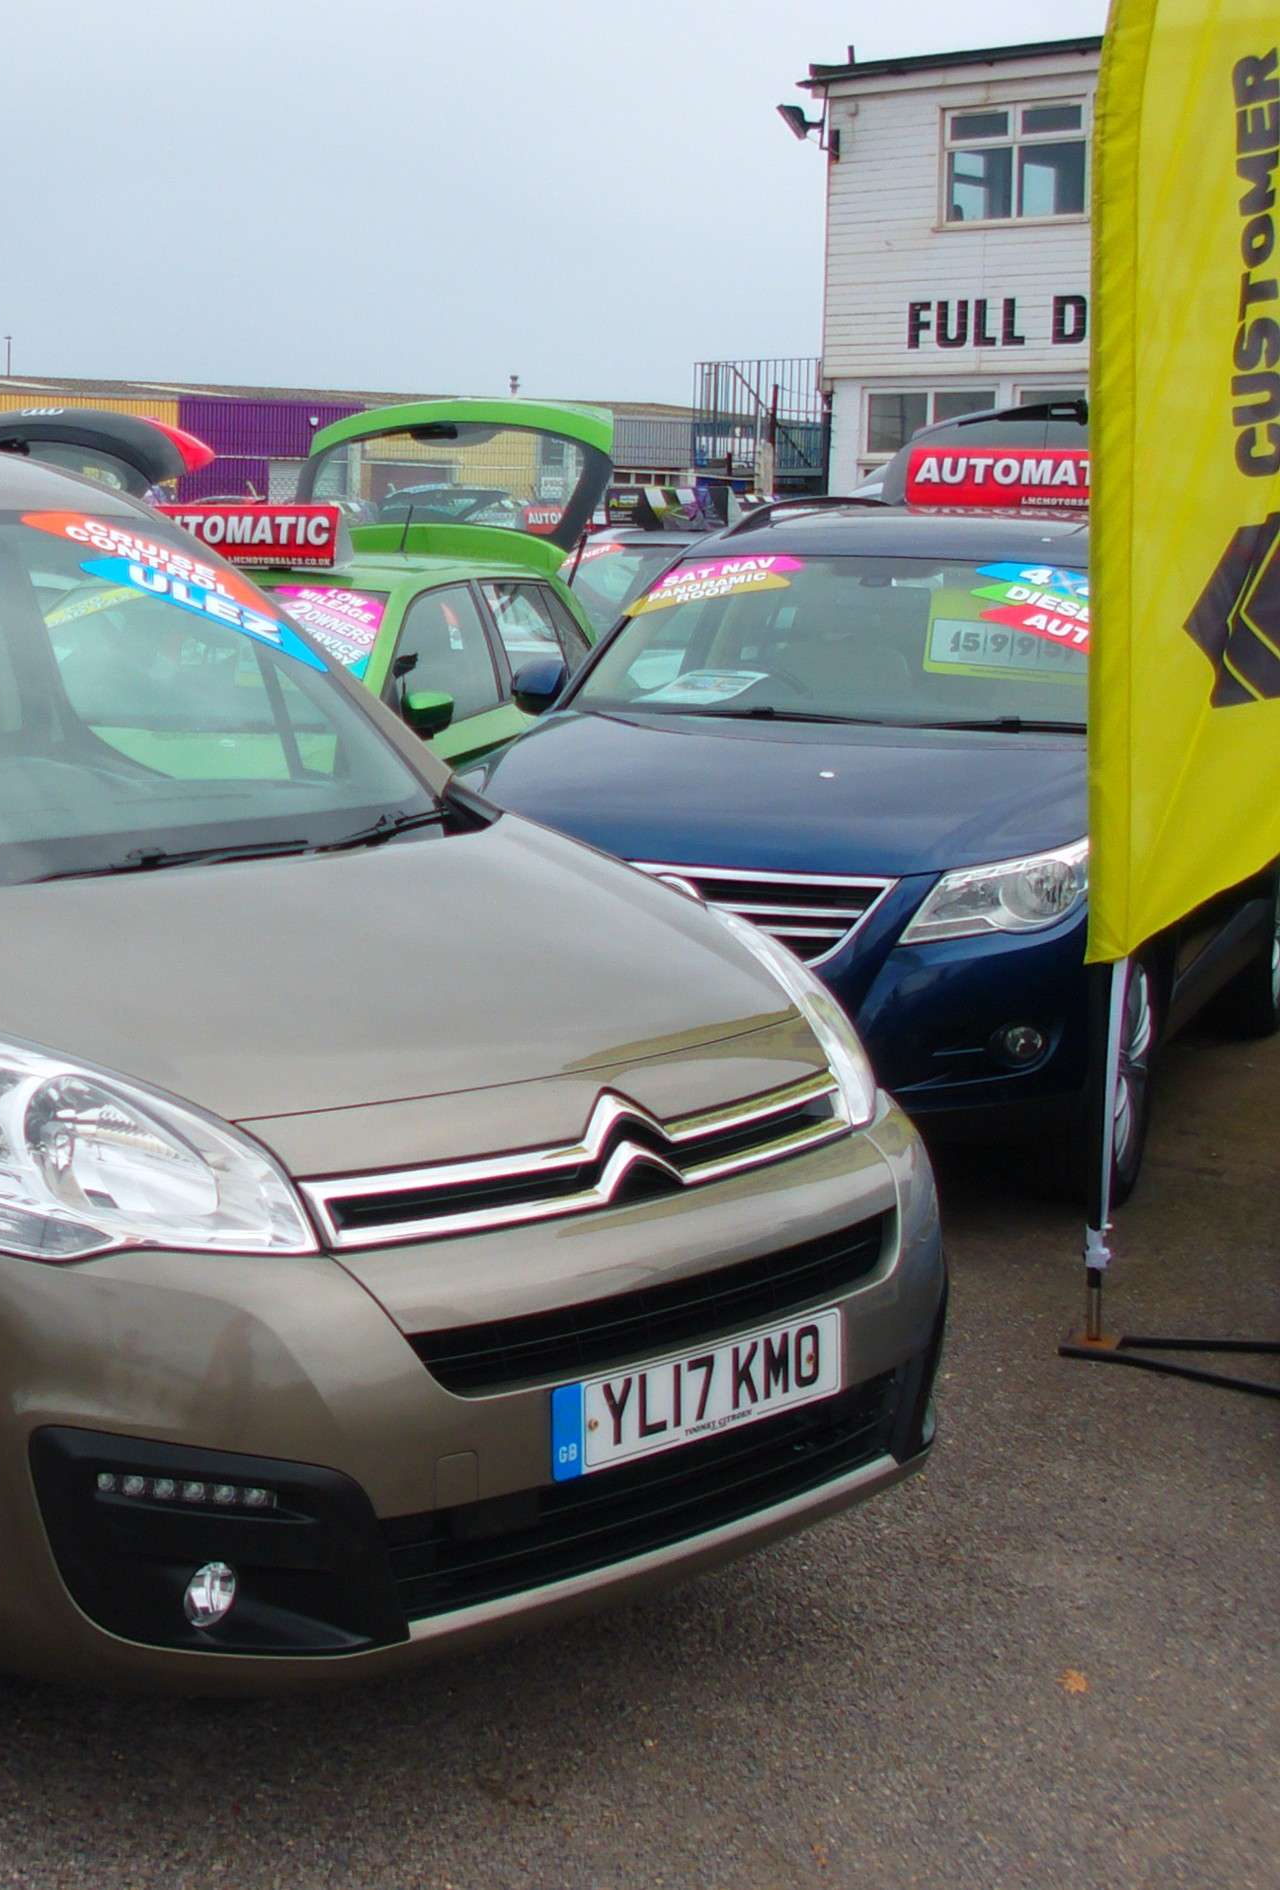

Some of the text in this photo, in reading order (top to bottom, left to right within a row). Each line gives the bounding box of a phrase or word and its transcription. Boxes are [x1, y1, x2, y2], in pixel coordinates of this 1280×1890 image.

[1231, 46, 1280, 478] CUSTOMER
[907, 299, 1026, 350] FULL
[174, 515, 330, 546] TOMATIC
[65, 525, 235, 601] CONTROL
[83, 521, 217, 582] CRUISE
[647, 572, 768, 603] PANORAMIC
[662, 556, 777, 588] SAT NAV
[128, 563, 283, 646] ULEZ
[296, 589, 376, 624] MILEAGE
[326, 588, 369, 607] LOW
[676, 584, 734, 603] ROOF
[304, 609, 375, 645] OWNERS
[305, 627, 366, 661] RVICE
[602, 1323, 820, 1446] YL17 KMO
[558, 1443, 578, 1464] GB
